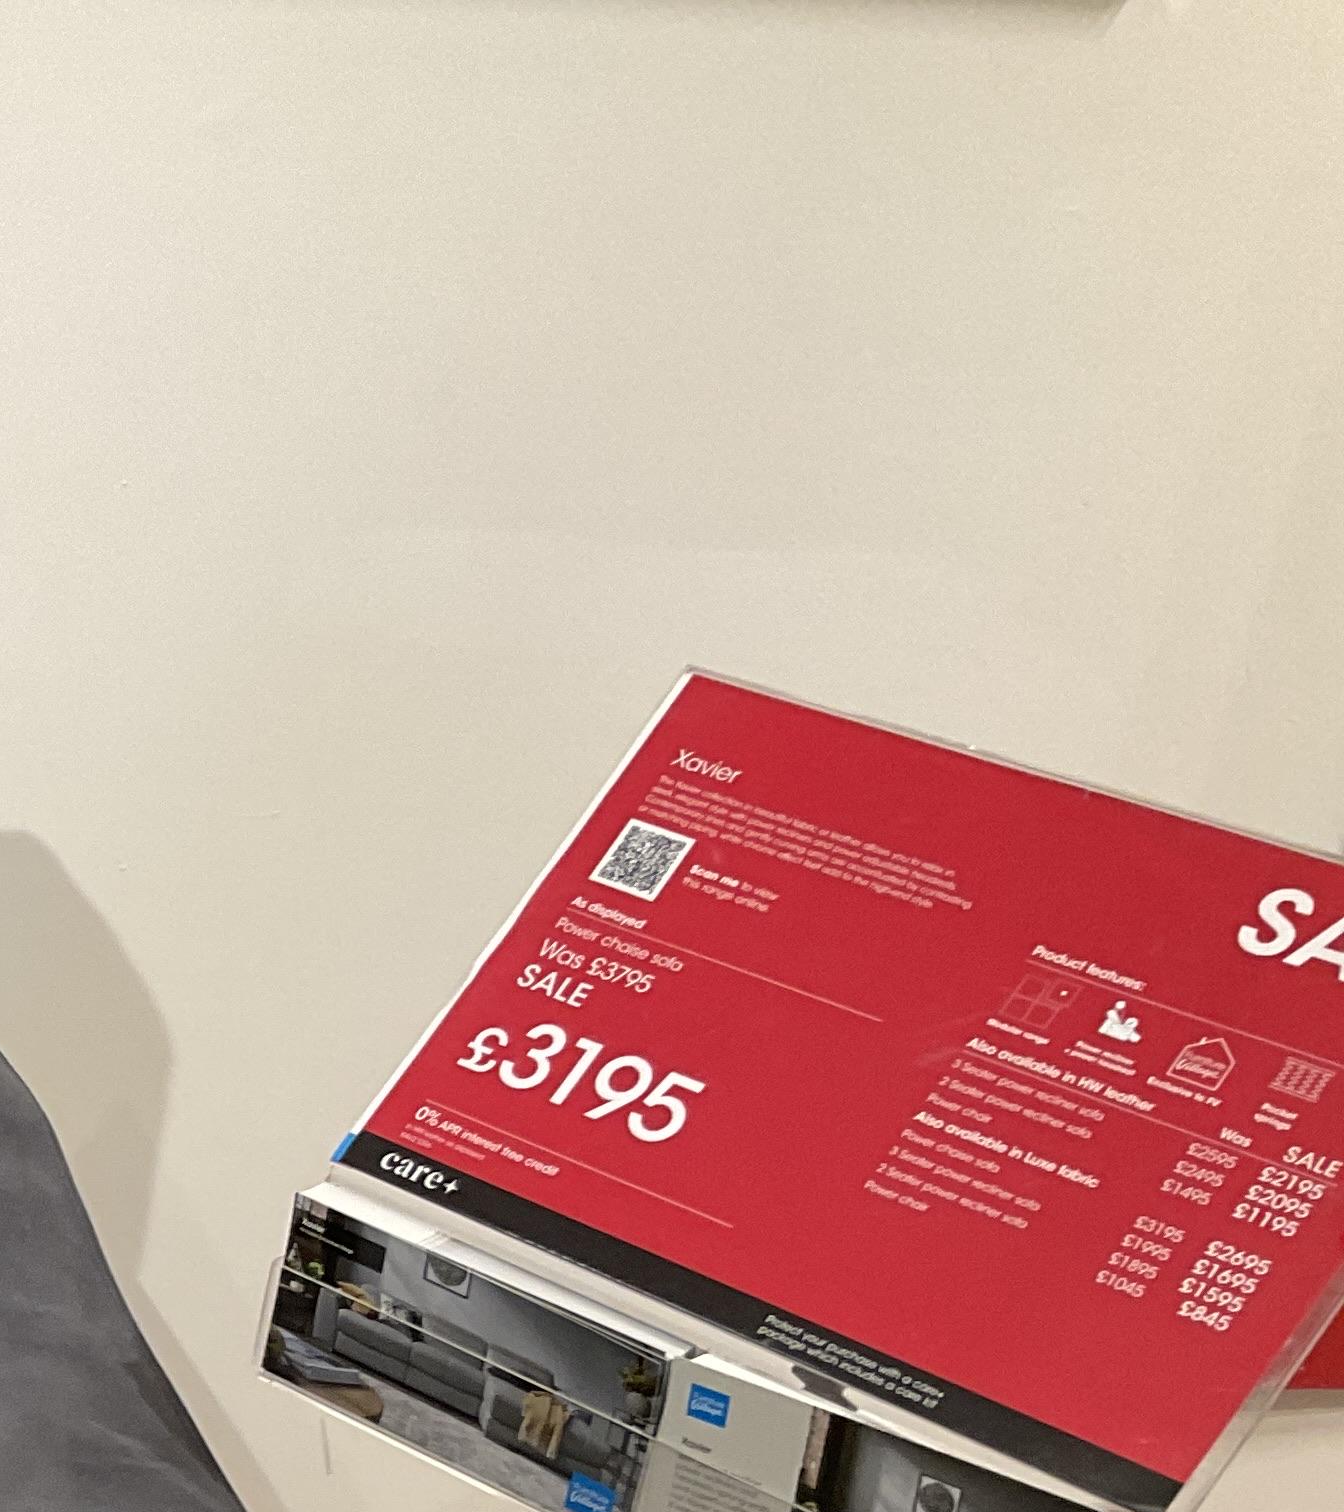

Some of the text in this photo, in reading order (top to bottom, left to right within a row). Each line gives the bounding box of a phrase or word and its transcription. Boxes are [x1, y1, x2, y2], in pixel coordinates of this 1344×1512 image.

[670, 748, 742, 782] Xavier
[689, 864, 719, 880] Scan
[719, 876, 739, 887] me
[570, 896, 646, 928] As displayed
[554, 916, 683, 971] Power chaise sofa
[1031, 944, 1087, 970] Product
[539, 937, 655, 992] Was £3795
[516, 963, 593, 1007] SALE
[456, 1023, 705, 1141] £3195
[965, 1037, 996, 1054] Also
[997, 1050, 1061, 1078] available
[1061, 1071, 1076, 1083] in
[1102, 1086, 1156, 1111] leather
[414, 1106, 441, 1126] 0%
[437, 1120, 462, 1135] APR
[460, 1131, 502, 1151] interest
[500, 1146, 523, 1161] free
[524, 1158, 559, 1175] credit
[912, 1111, 1099, 1187] Also available in Luxe fabric
[1186, 1142, 1238, 1168] £2595
[1220, 1127, 1343, 1177] Was SALE
[1173, 1160, 1224, 1186] £2495
[1257, 1166, 1326, 1199] £2195
[1160, 1178, 1212, 1205] £1495
[1244, 1184, 1312, 1218] £2095
[1133, 1215, 1185, 1242] £3195
[1231, 1202, 1299, 1236] £1195
[1121, 1233, 1172, 1260] £1995
[1204, 1240, 1271, 1274] £2695
[1107, 1251, 1158, 1278] £1895
[1191, 1259, 1258, 1293] £1695
[1095, 1269, 1145, 1297] £1045
[1178, 1277, 1245, 1312] £1595
[1176, 1300, 1232, 1330] £845
[756, 1325, 806, 1350] package
[764, 1314, 803, 1335] Protect
[824, 1343, 877, 1369] purchase
